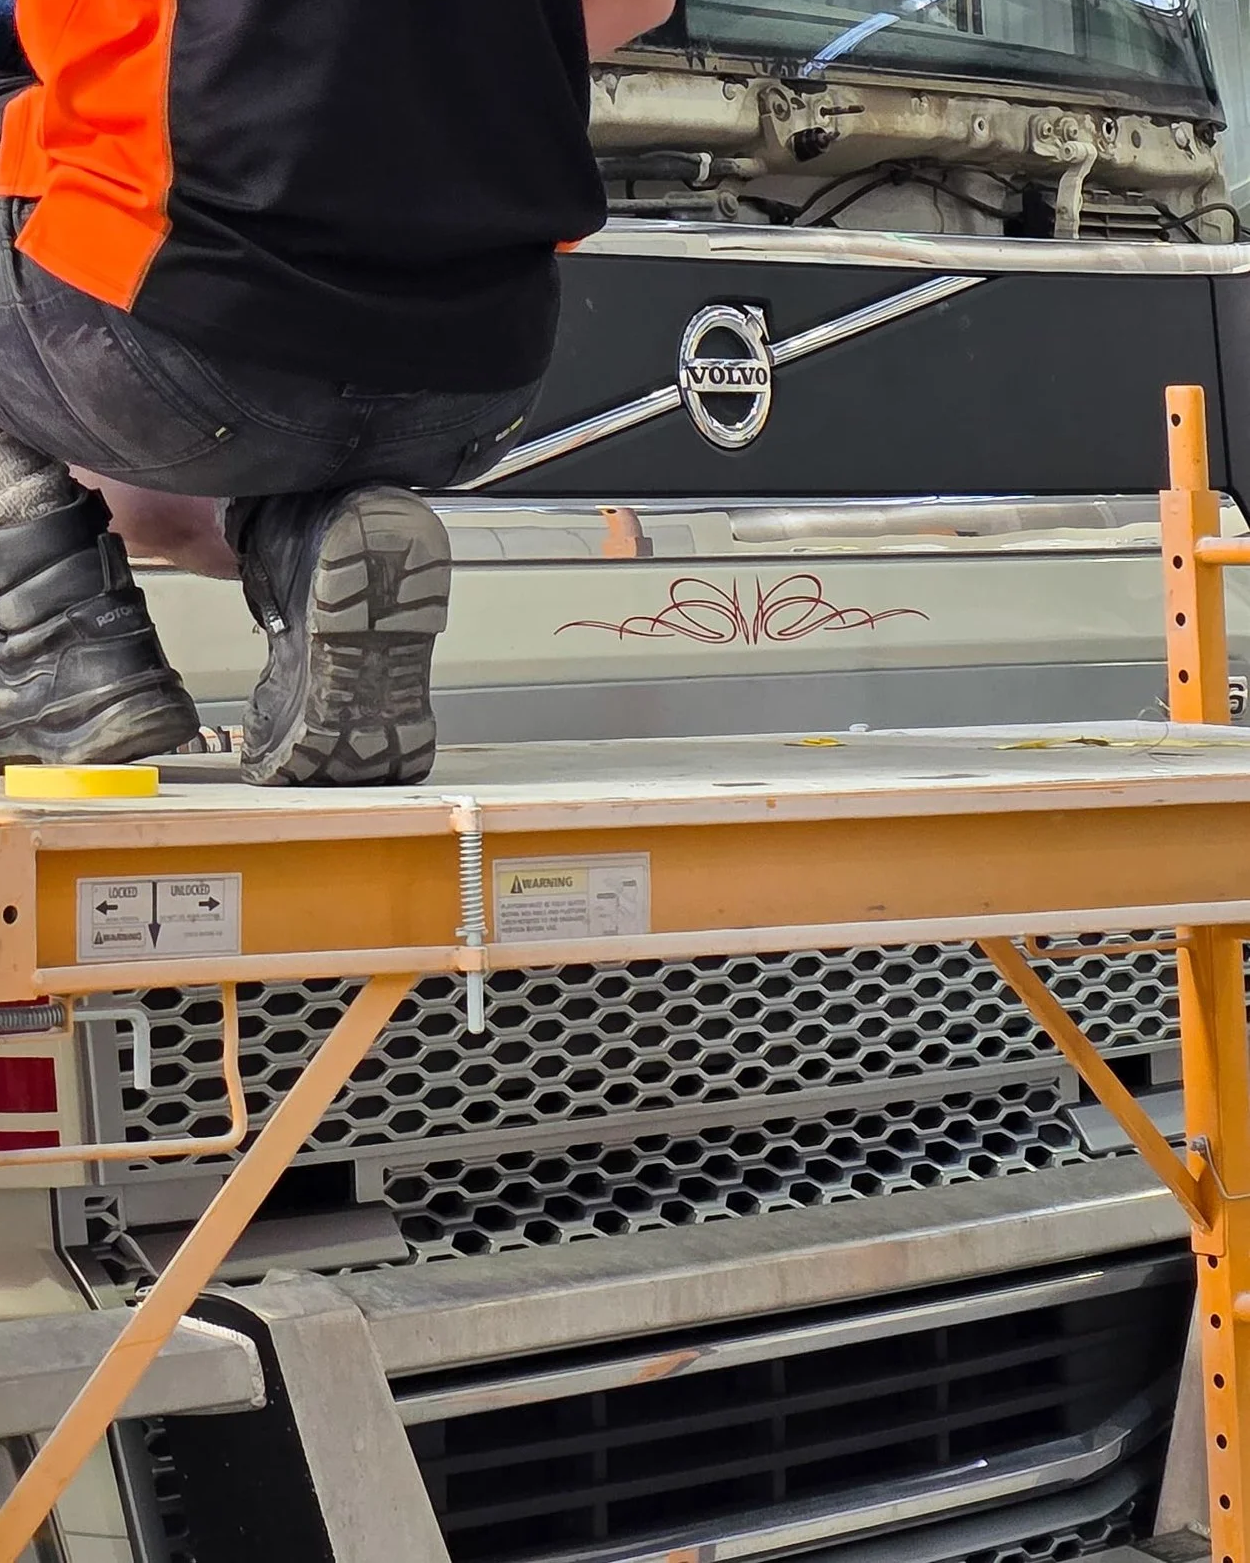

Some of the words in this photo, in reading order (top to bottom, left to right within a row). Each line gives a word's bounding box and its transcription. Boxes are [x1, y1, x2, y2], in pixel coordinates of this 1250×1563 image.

[685, 366, 768, 386] VOLVO
[523, 876, 573, 889] WARNING
[109, 886, 138, 898] LOCKED
[171, 883, 210, 897] UNLOCKED
